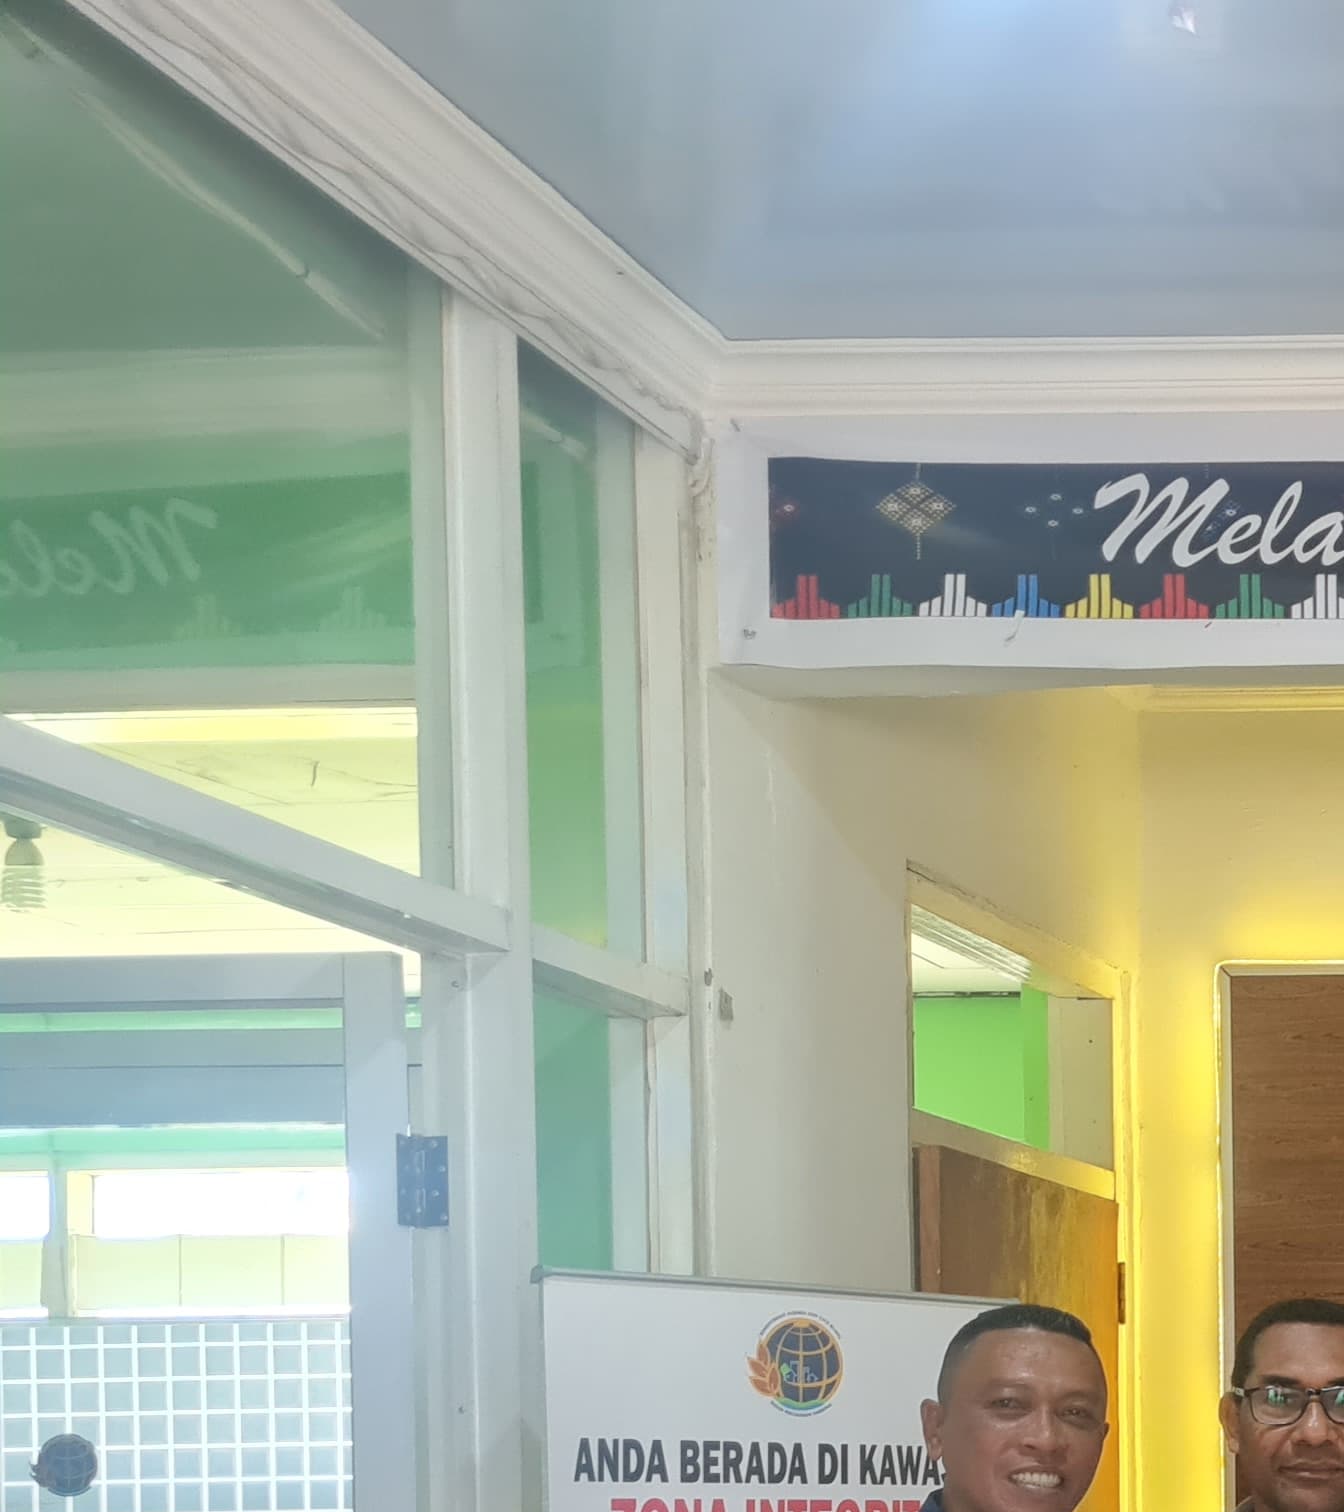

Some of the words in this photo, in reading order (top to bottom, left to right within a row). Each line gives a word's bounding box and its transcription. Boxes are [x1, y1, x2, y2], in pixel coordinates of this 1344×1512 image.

[574, 1437, 669, 1484] ANDA
[680, 1440, 807, 1486] BERADA
[819, 1443, 848, 1485] DI
[860, 1443, 946, 1486] KAWA
